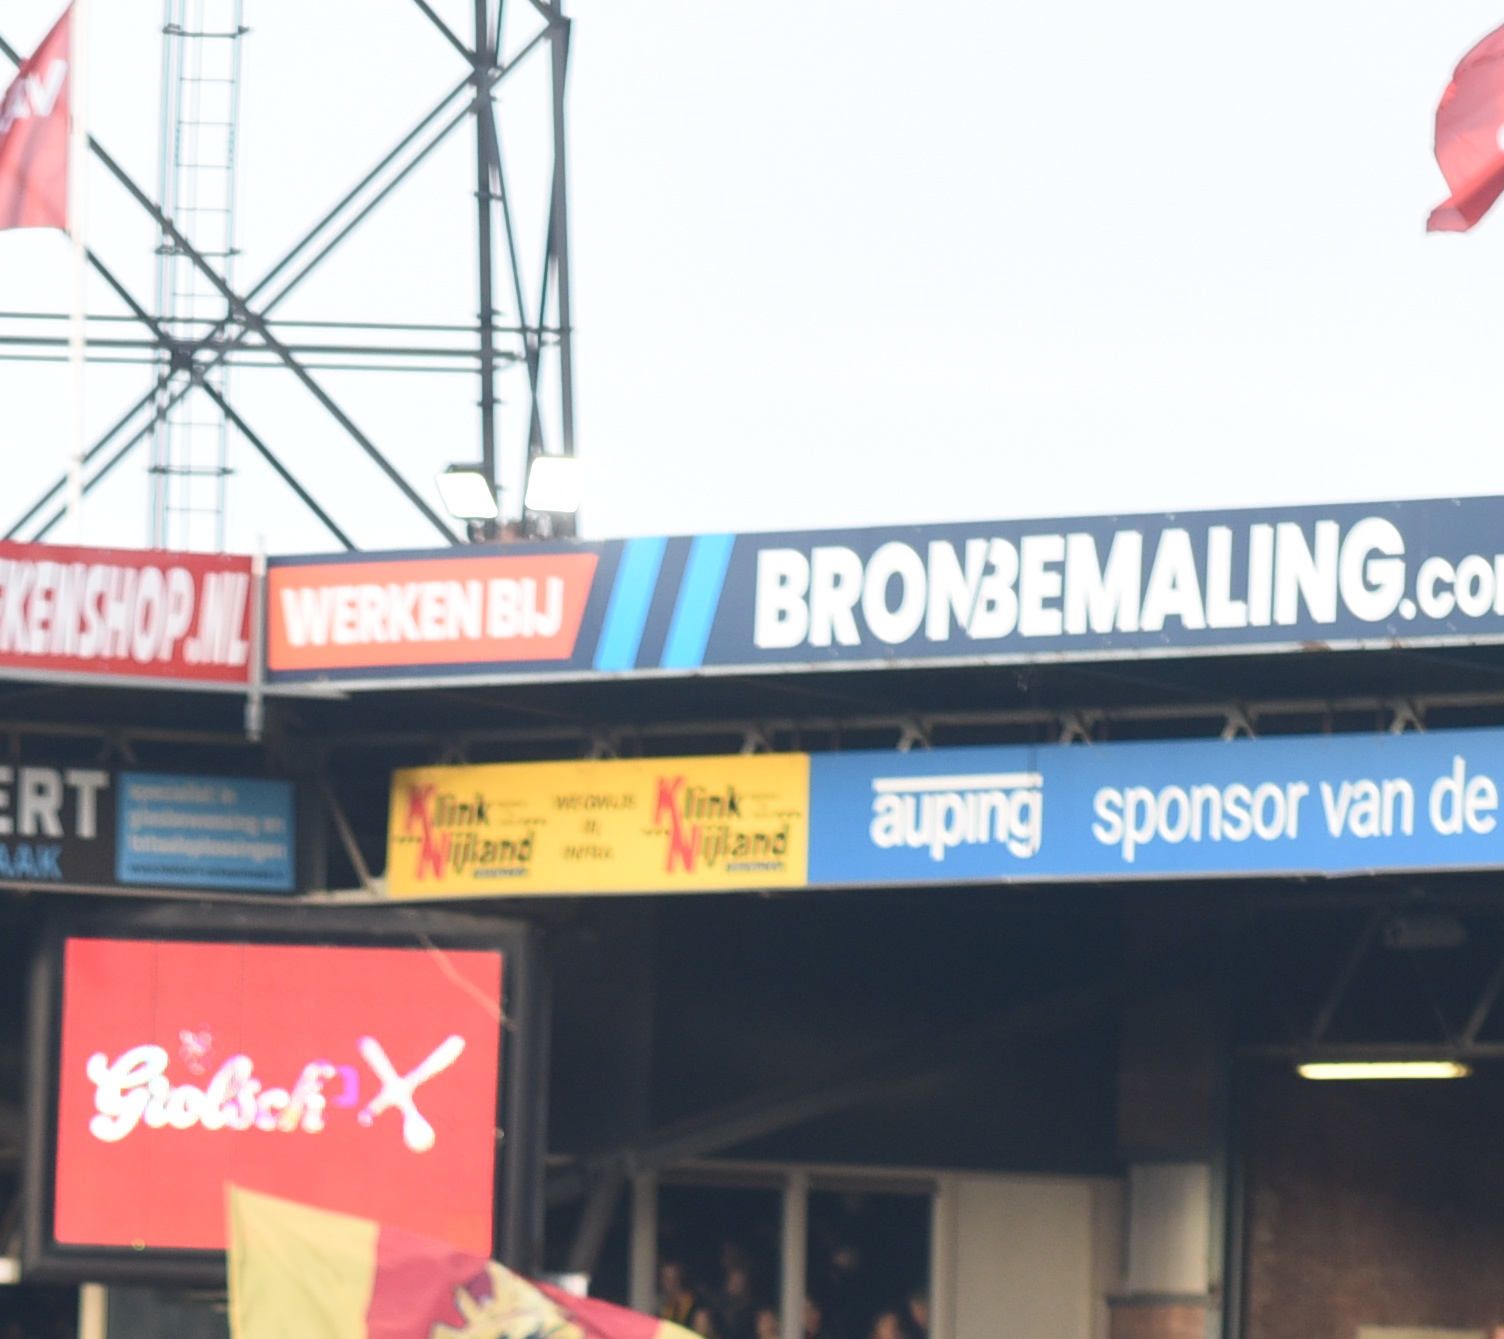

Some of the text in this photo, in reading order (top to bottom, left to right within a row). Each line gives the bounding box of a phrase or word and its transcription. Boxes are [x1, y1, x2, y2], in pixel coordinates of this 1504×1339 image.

[280, 576, 565, 648] WERKEN BIJ
[870, 780, 1043, 861] auping
[1090, 773, 1302, 863] sponsor
[1319, 773, 1412, 840] van
[1425, 754, 1500, 837] de
